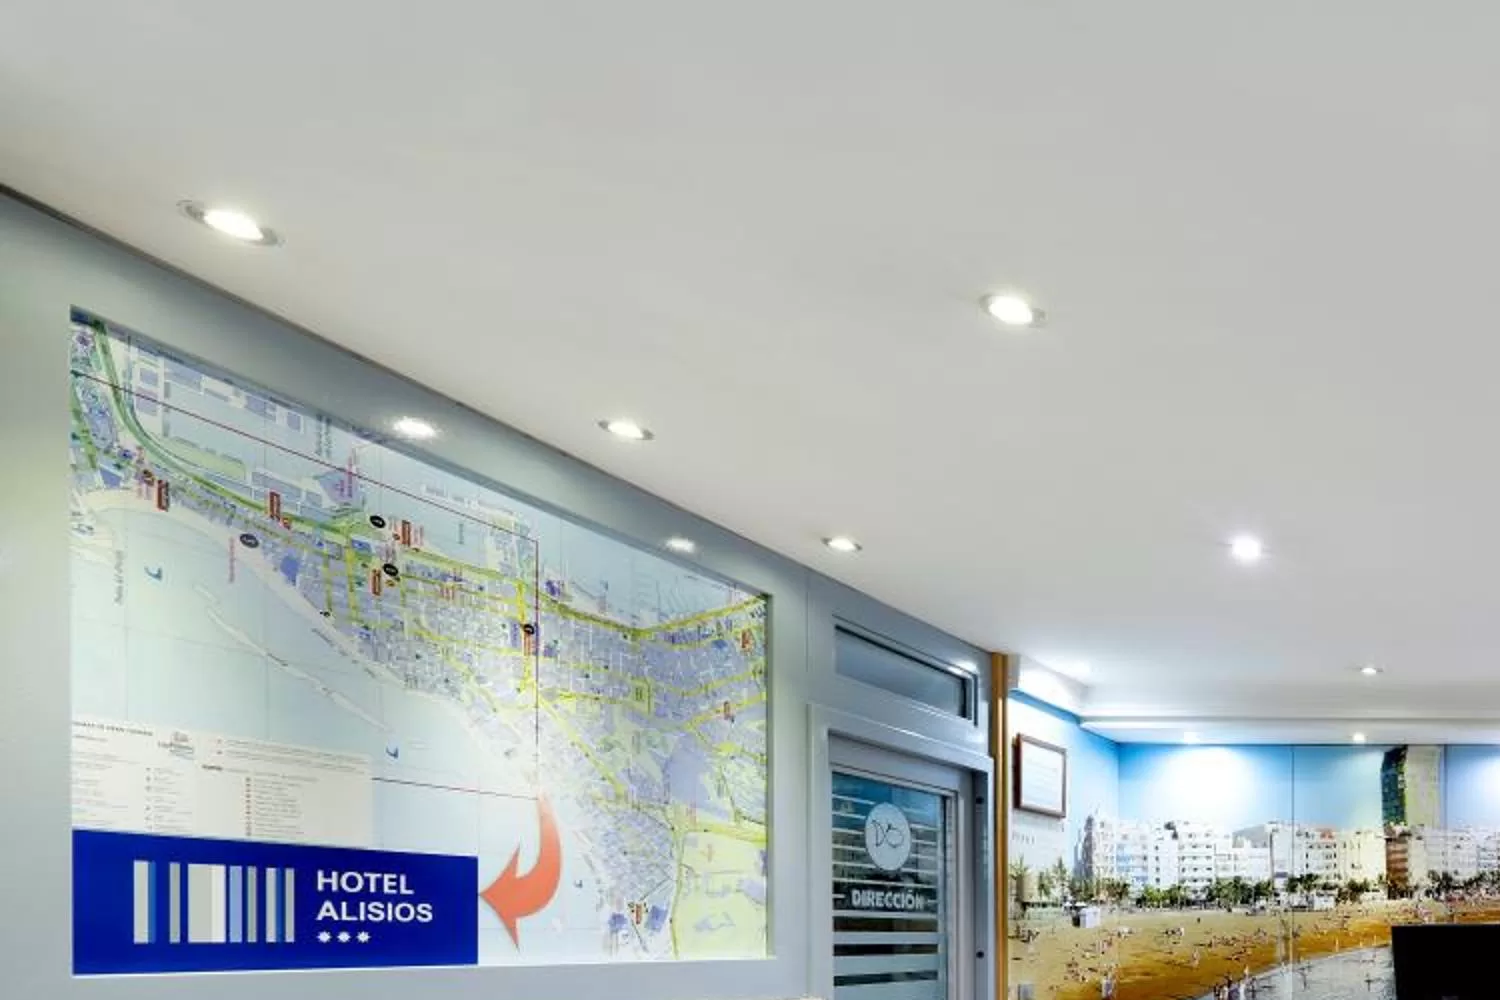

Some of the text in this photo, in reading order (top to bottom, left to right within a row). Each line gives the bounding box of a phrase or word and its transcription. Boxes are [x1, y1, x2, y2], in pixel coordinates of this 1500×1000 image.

[317, 869, 415, 895] HOTEL
[316, 899, 434, 923] ALISIOS
[851, 889, 925, 910] DIRECCIÓN
